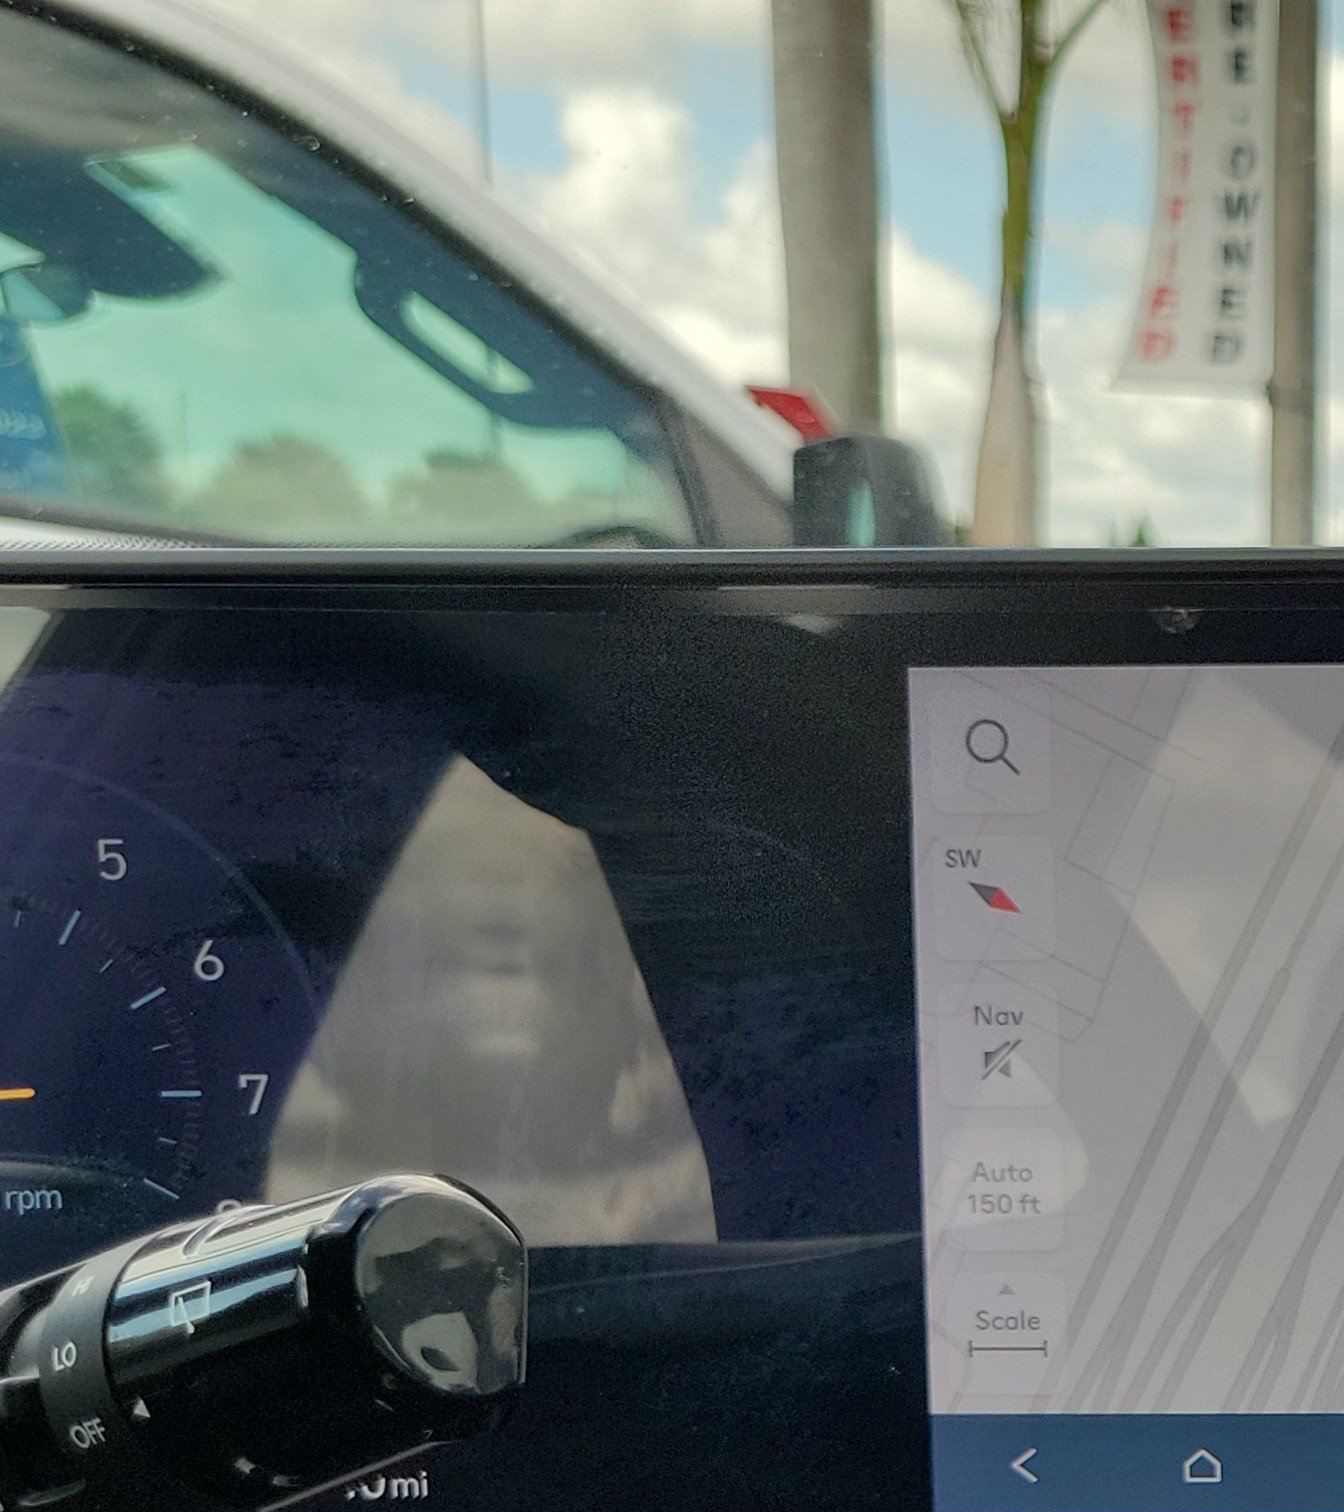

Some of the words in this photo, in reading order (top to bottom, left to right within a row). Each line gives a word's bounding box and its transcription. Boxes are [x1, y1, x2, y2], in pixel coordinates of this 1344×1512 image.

[99, 838, 127, 881] 5
[944, 848, 982, 869] SW
[195, 940, 225, 981] 6
[973, 1005, 1025, 1027] Nav
[237, 1073, 269, 1116] 7
[971, 1162, 1034, 1183] Auto
[4, 1189, 63, 1214] rpm
[967, 1195, 1013, 1214] 150
[1019, 1194, 1042, 1214] ft
[975, 1310, 1042, 1332] Scale
[52, 1342, 76, 1371] LO
[68, 1417, 106, 1449] OFF
